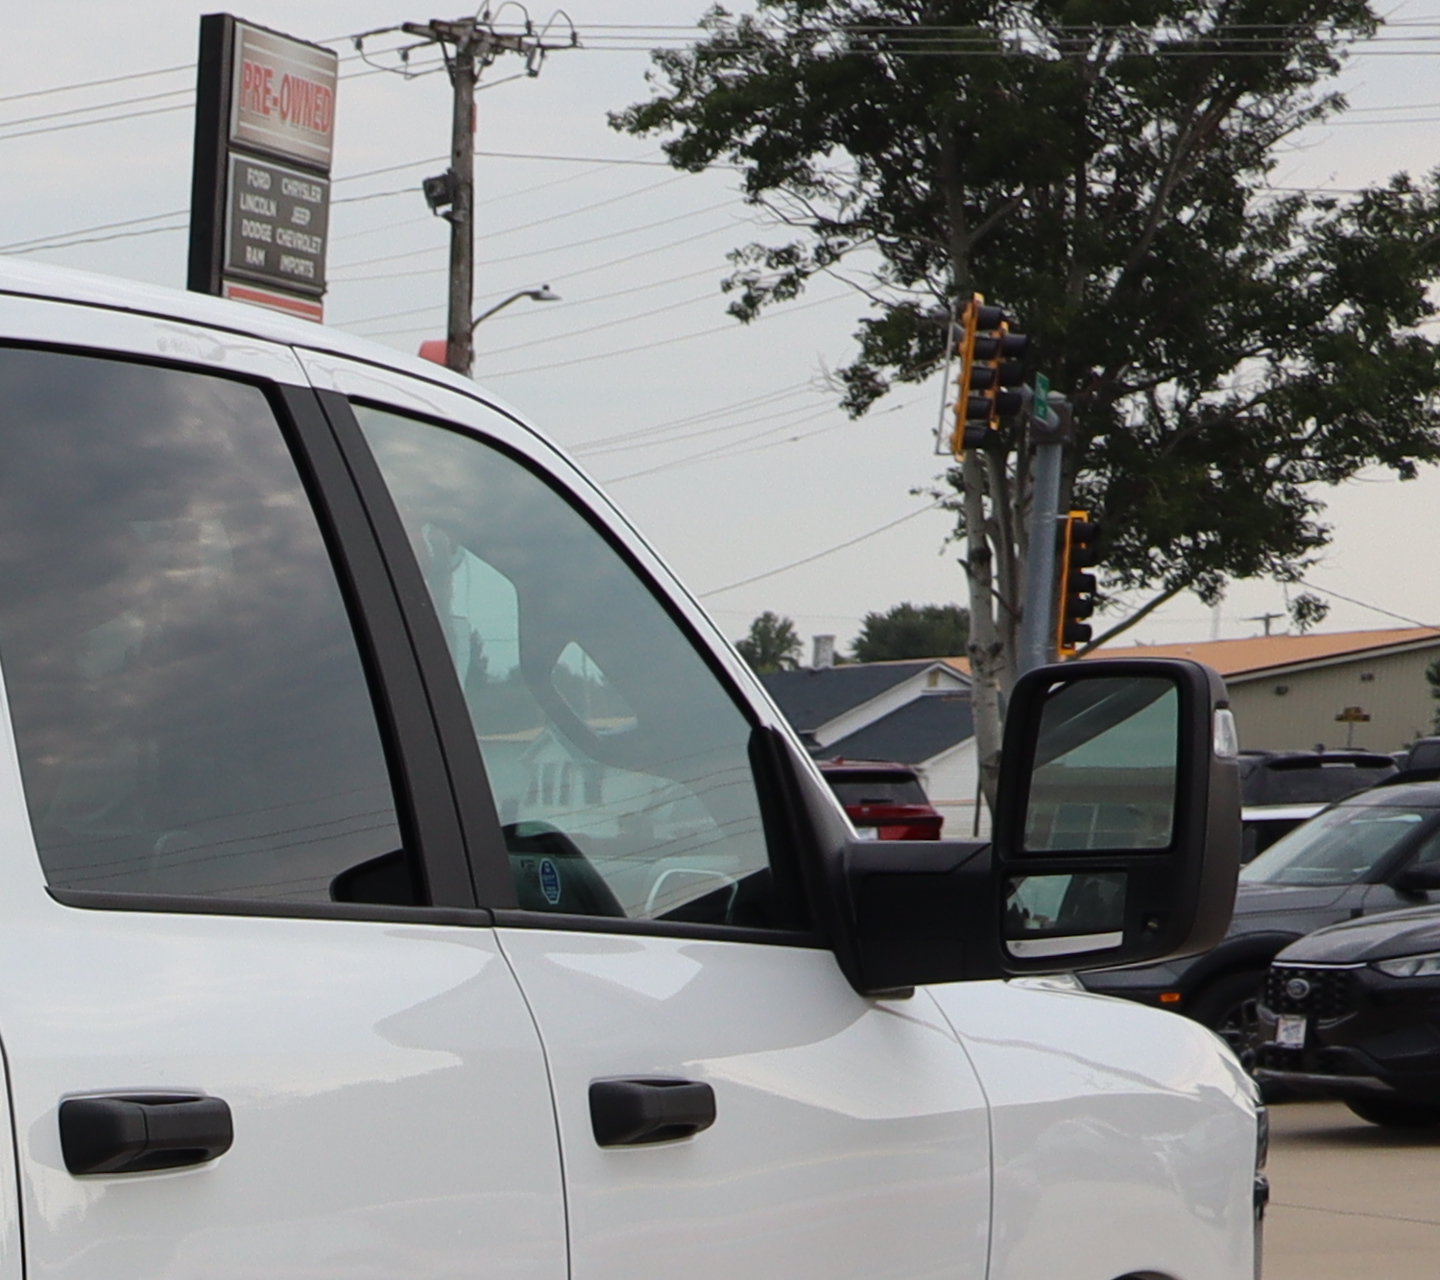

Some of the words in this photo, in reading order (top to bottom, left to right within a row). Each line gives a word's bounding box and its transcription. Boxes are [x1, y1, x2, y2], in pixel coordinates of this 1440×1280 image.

[241, 60, 332, 133] PRE-OWNED
[247, 167, 271, 190] FORD
[282, 177, 322, 203] CHRYSLER
[240, 192, 277, 217] LINCOLN
[242, 218, 272, 243] DODGE
[276, 227, 322, 254] CHEVROLET
[246, 245, 265, 266] RAM
[280, 254, 314, 278] IMPORTS
